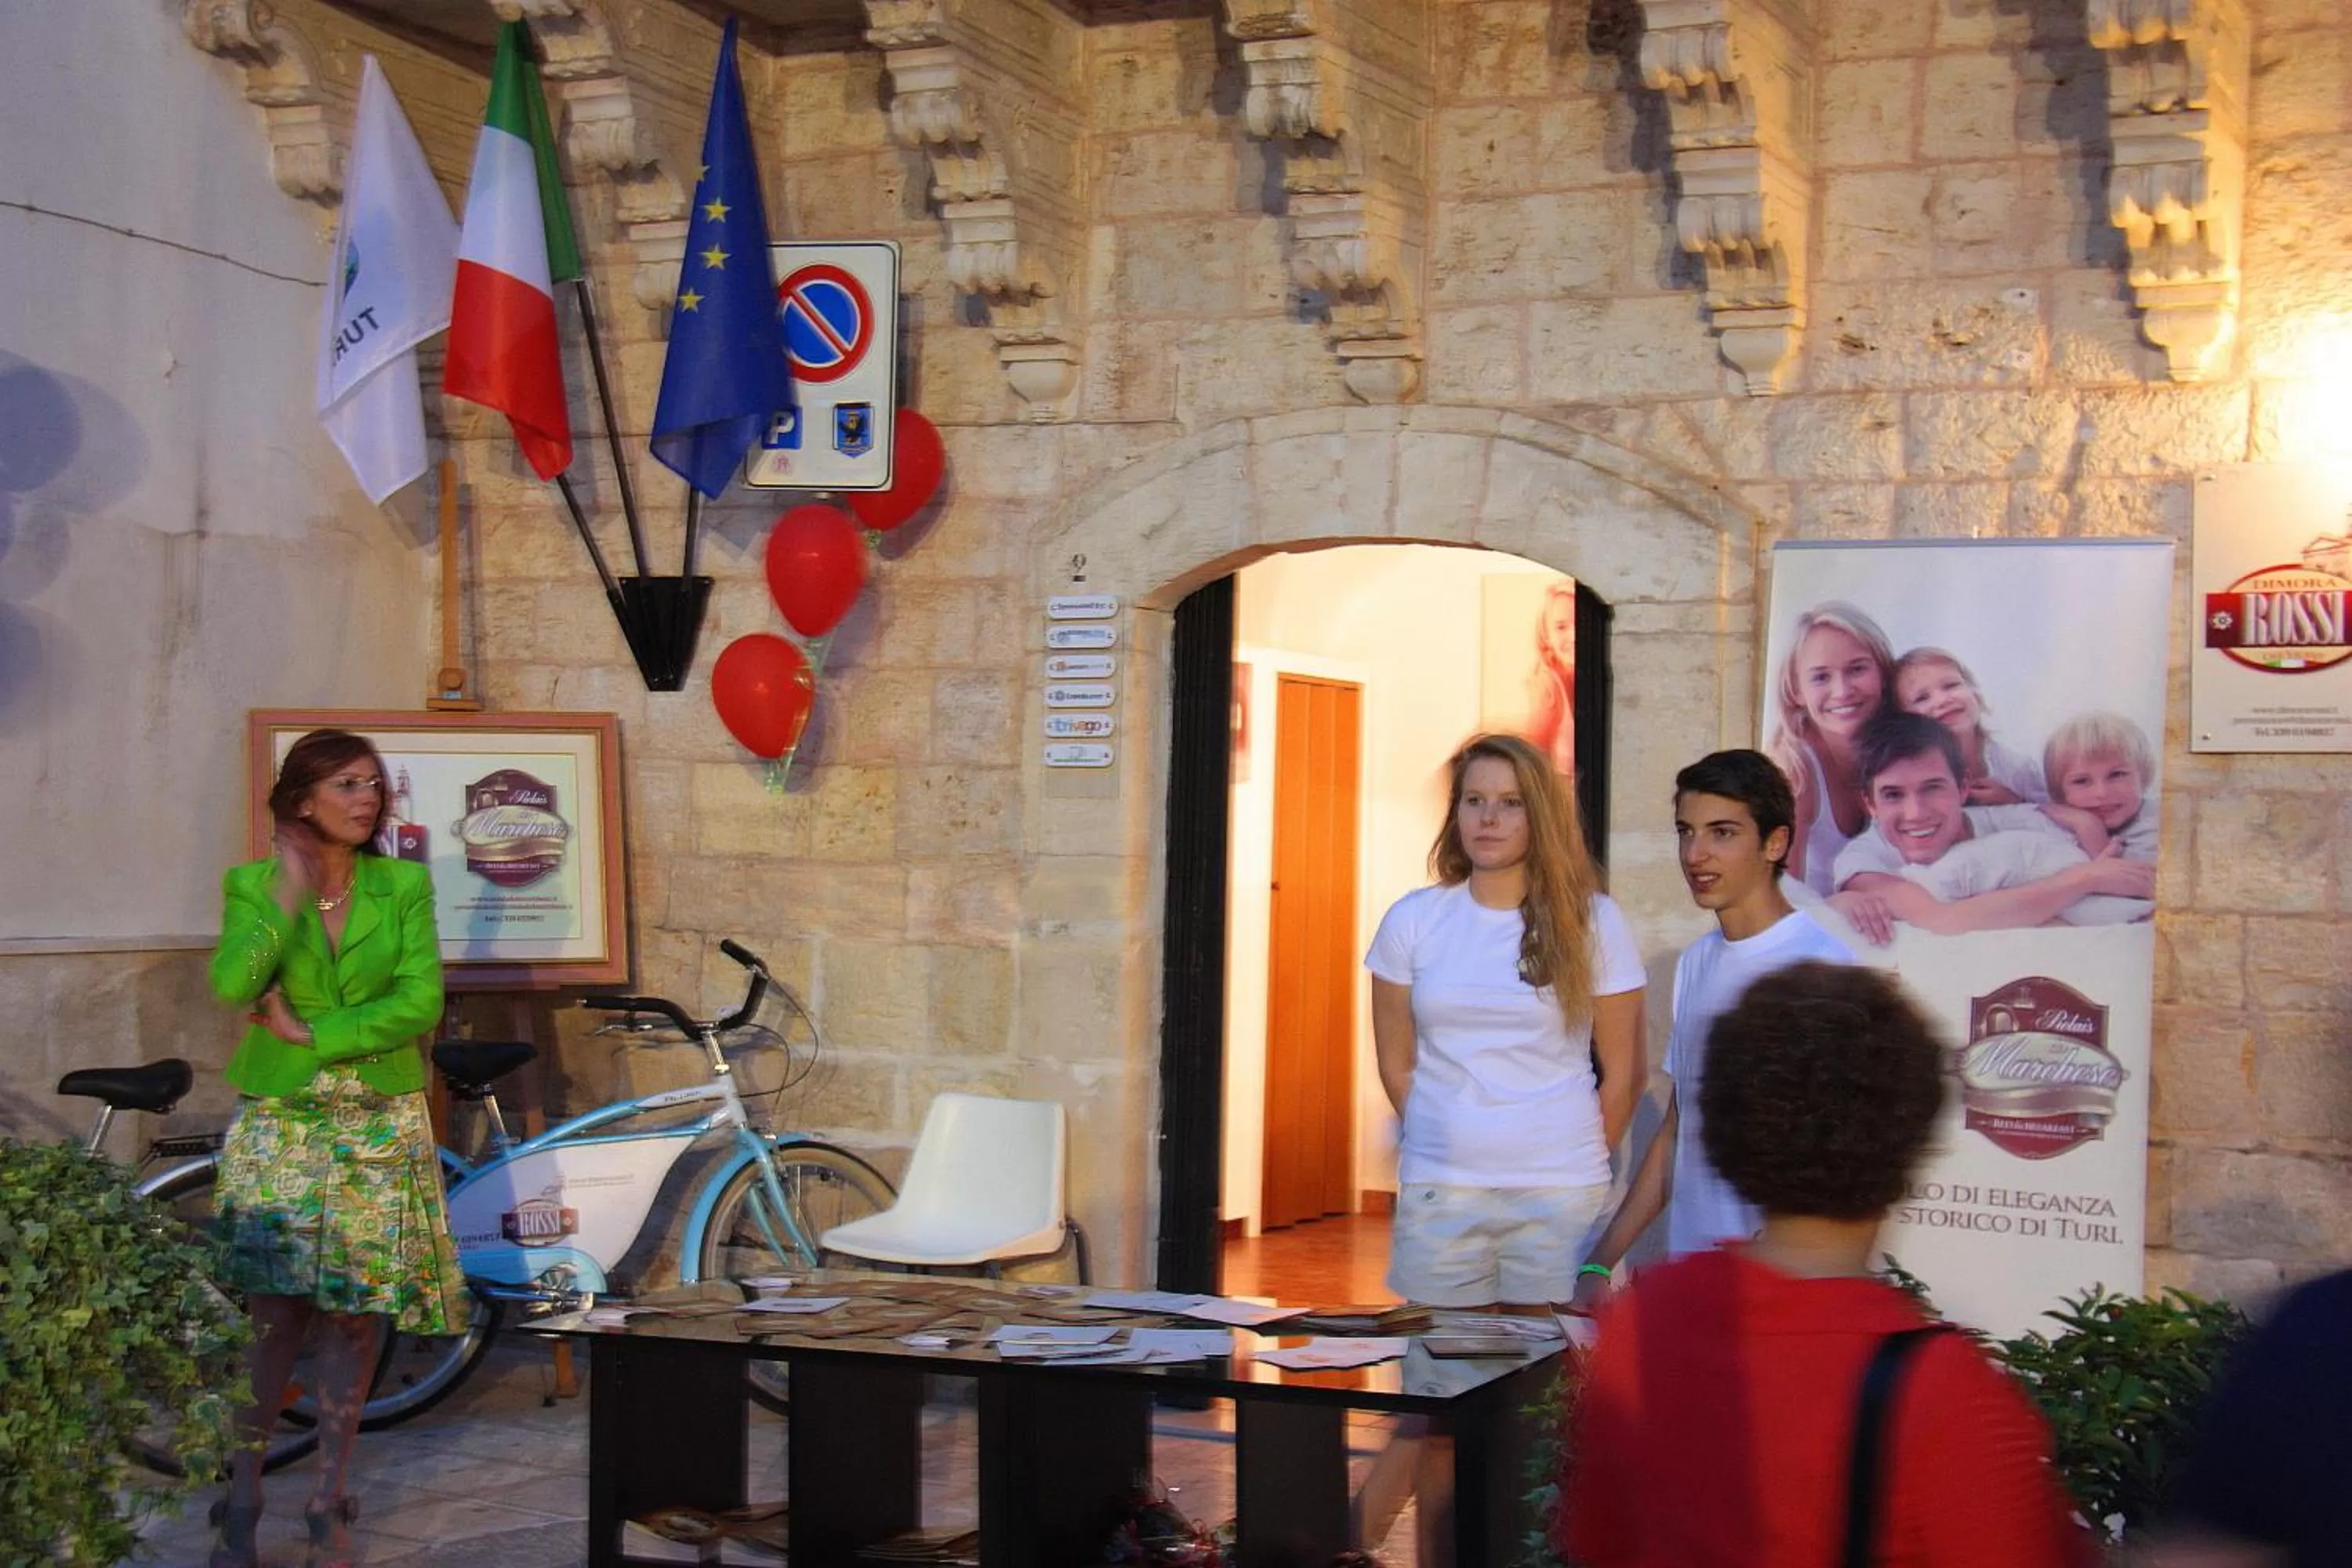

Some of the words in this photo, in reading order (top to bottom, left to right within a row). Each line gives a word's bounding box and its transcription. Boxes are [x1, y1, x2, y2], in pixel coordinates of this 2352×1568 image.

[2242, 590, 2344, 645] ROSSI
[1952, 1184, 1980, 1205] DI
[1988, 1187, 2118, 1218] ELEGANZA
[1898, 1206, 2011, 1233] STORICO
[2020, 1217, 2046, 1237] DI
